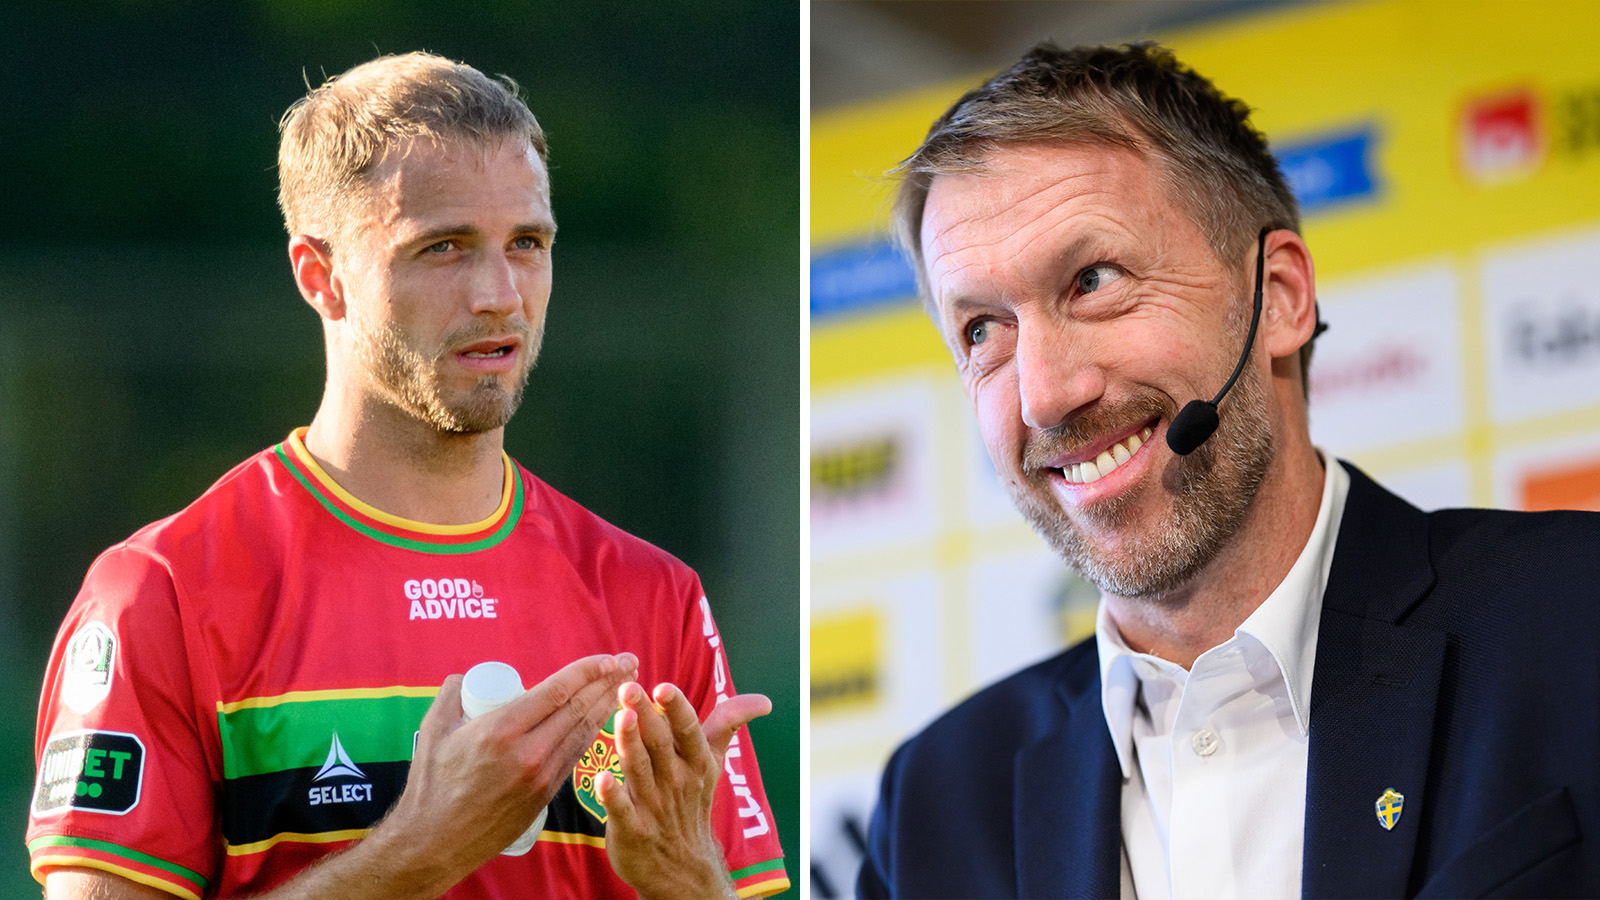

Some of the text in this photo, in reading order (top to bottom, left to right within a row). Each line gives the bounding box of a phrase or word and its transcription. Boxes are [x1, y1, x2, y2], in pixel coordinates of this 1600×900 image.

[404, 578, 471, 600] GOOD
[409, 598, 498, 620] ADVICE
[308, 784, 373, 806] SELECT
